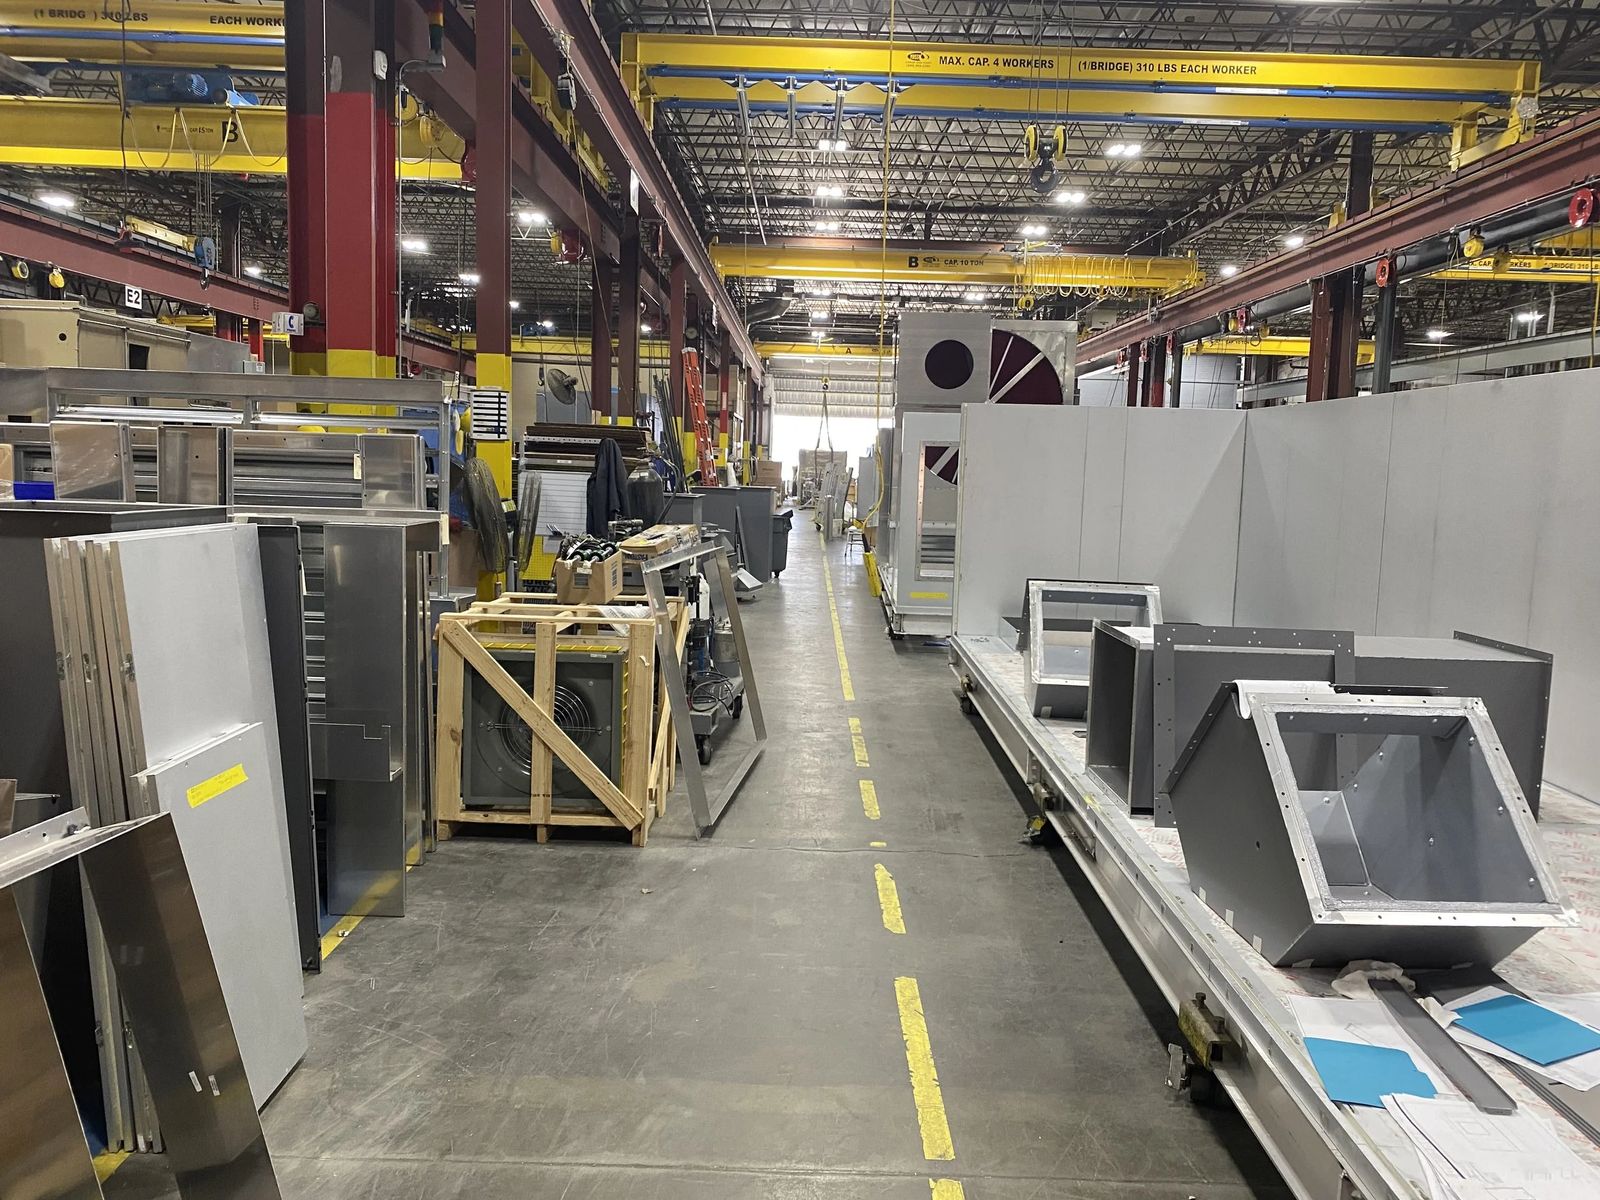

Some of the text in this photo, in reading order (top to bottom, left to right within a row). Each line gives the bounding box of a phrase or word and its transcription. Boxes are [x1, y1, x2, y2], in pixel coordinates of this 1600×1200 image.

[209, 15, 242, 25] EACH
[939, 55, 965, 65] MAX.
[968, 57, 990, 66] CAP.
[993, 57, 999, 66] 4
[1002, 58, 1054, 68] WORKERS
[1078, 61, 1133, 74] (1/BRIDGE)
[1136, 62, 1154, 72] 310
[1158, 63, 1177, 73] LBS
[1180, 64, 1208, 74] EACH
[1212, 65, 1257, 75] WORKER
[221, 121, 239, 142] B
[908, 256, 918, 268] B
[127, 289, 140, 305] E2
